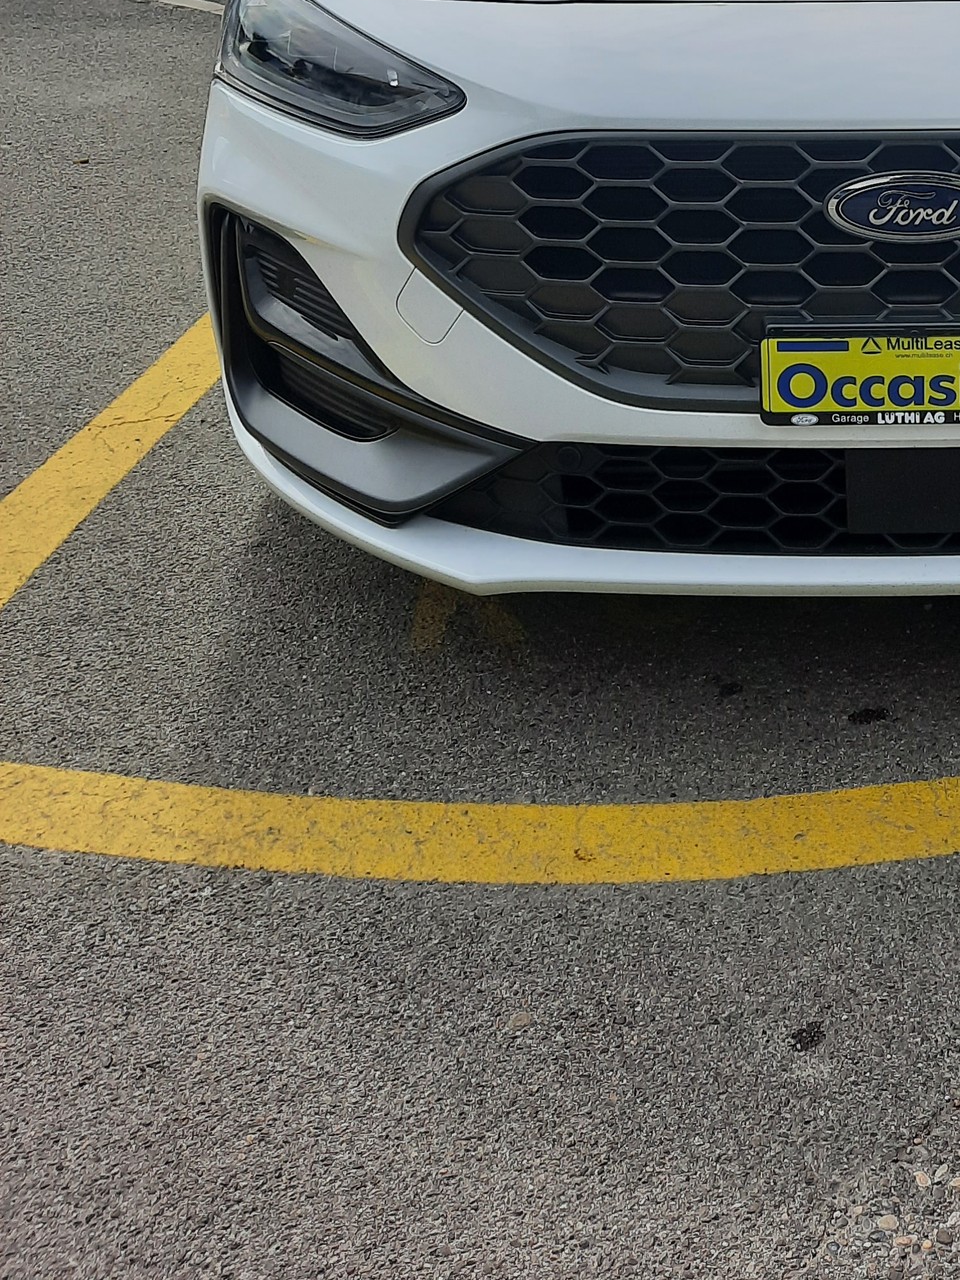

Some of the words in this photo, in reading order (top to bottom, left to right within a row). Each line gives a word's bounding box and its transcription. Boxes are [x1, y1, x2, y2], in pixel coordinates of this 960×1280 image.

[867, 189, 958, 226] Ford
[831, 413, 870, 424] Garage
[923, 411, 946, 424] AG
